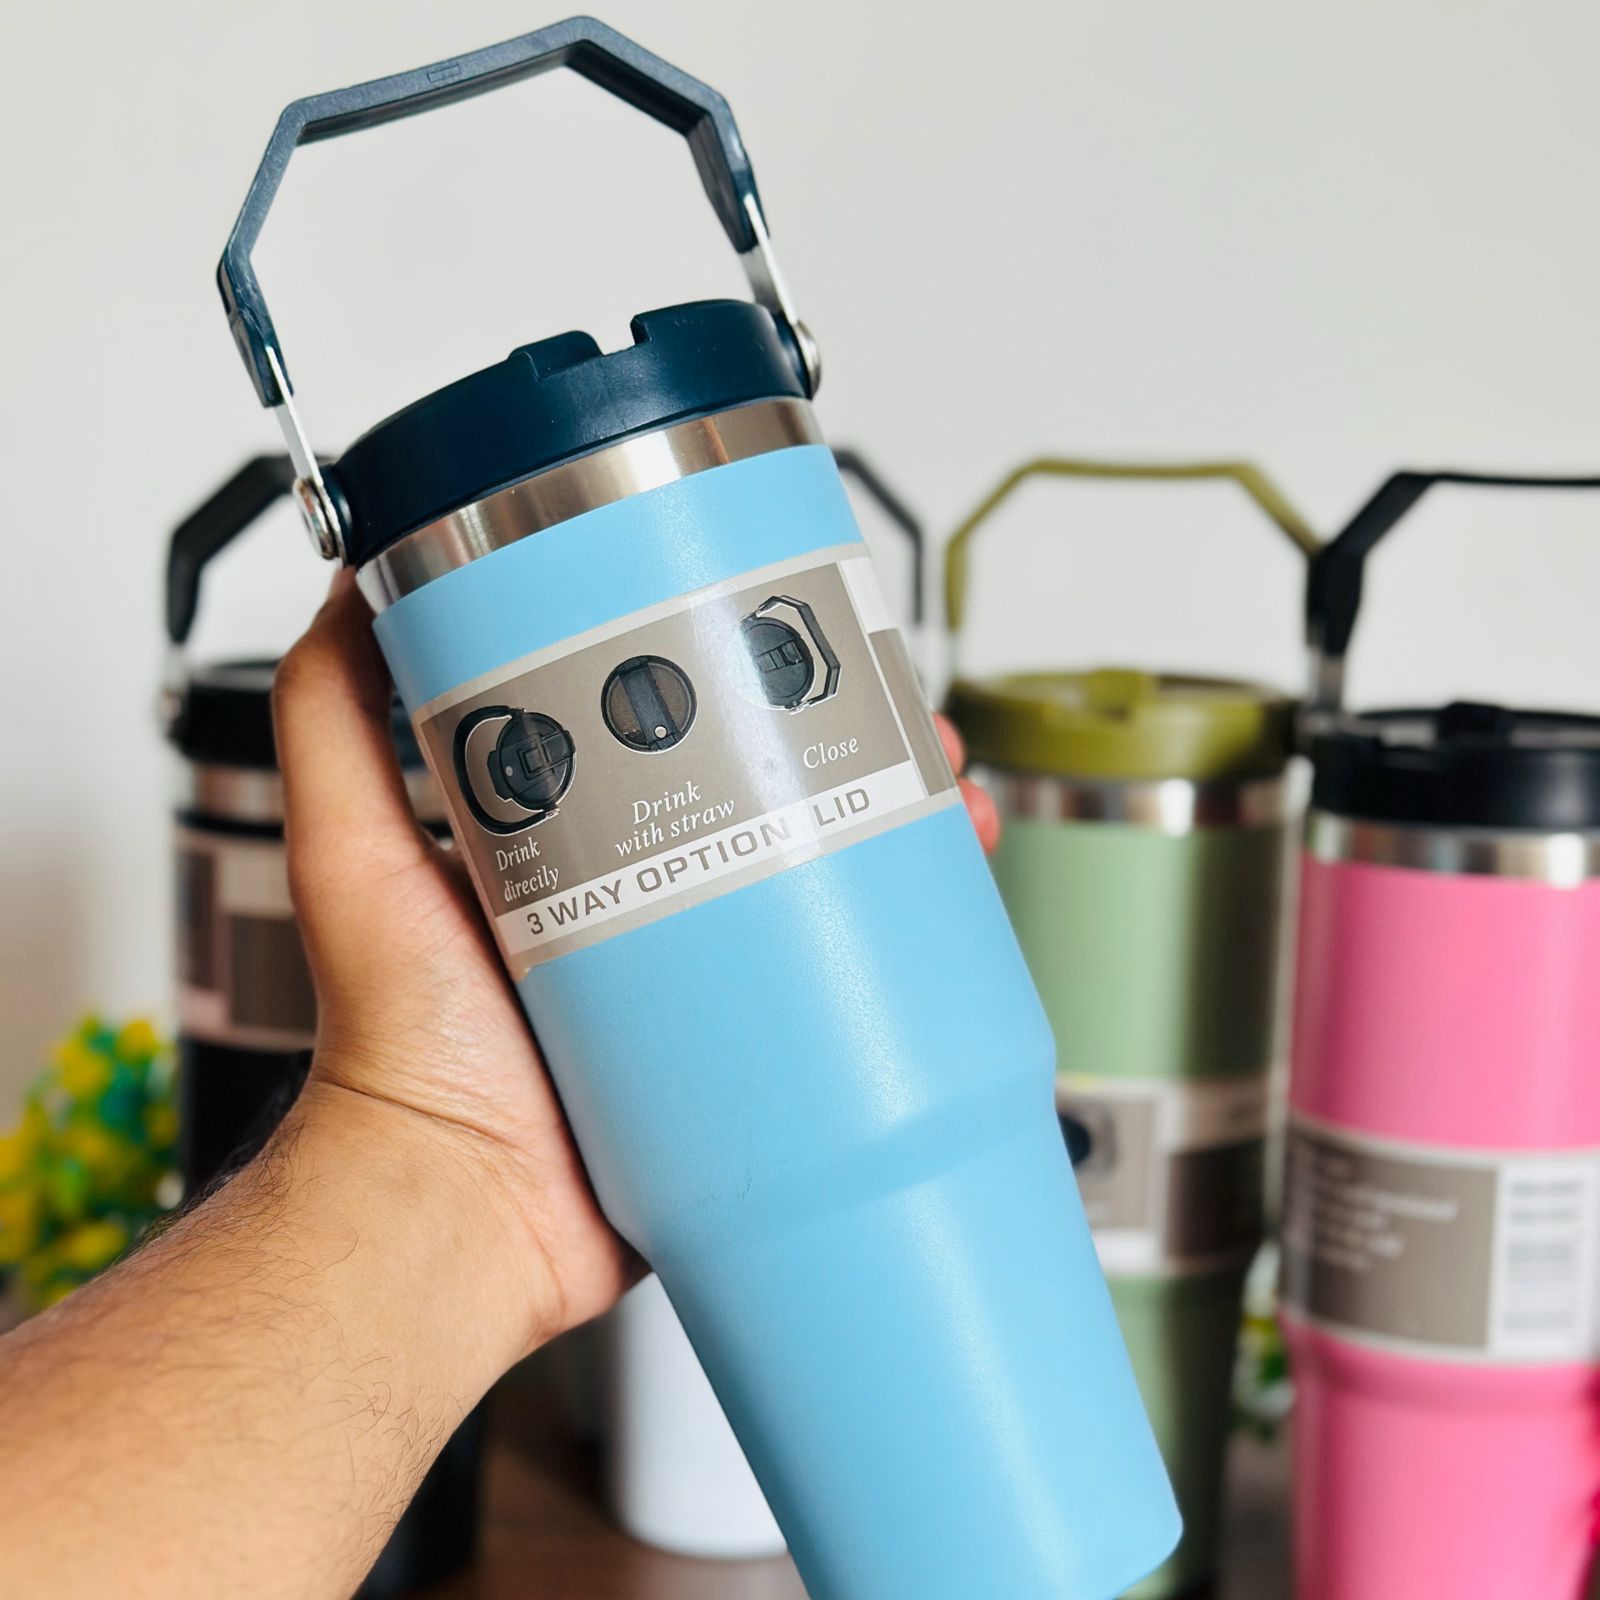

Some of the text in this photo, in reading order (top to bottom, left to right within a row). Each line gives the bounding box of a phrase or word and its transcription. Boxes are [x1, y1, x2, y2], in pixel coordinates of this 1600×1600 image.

[803, 738, 859, 768] Close
[632, 780, 701, 825] Drink
[615, 800, 735, 857] with straw
[496, 836, 541, 872] Drink
[527, 788, 870, 935] 3 WAY OPTION LID
